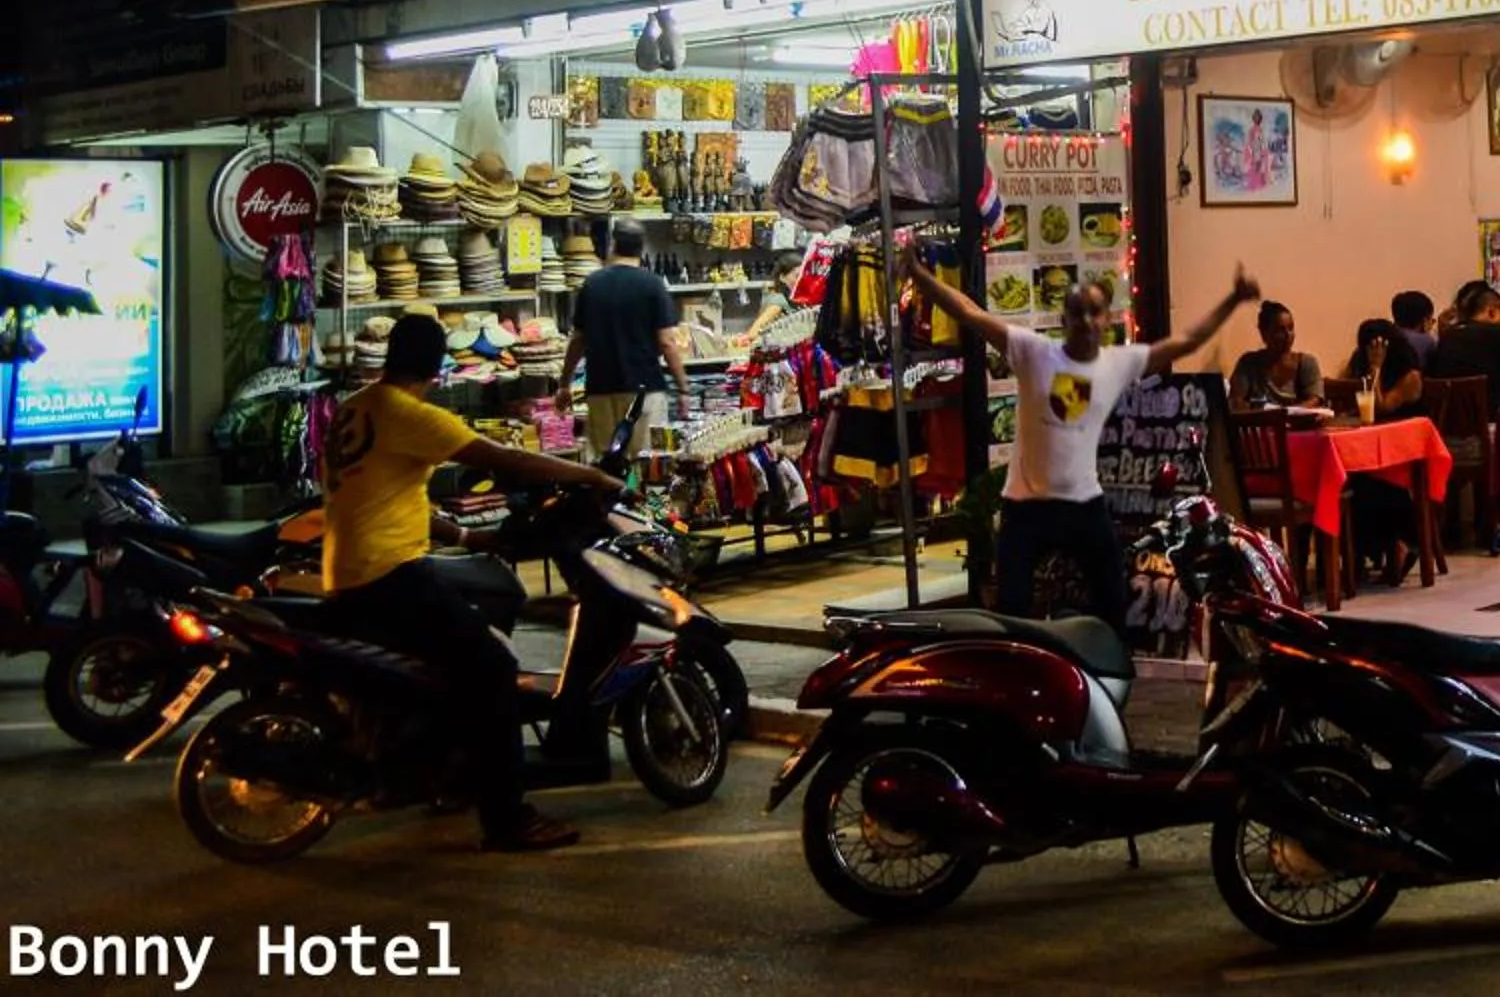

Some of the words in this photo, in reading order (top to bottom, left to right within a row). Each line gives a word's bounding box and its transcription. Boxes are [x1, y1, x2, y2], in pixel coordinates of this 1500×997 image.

[1143, 0, 1285, 47] CONTACT
[1003, 141, 1060, 169] CURRY
[1065, 141, 1099, 169] POT
